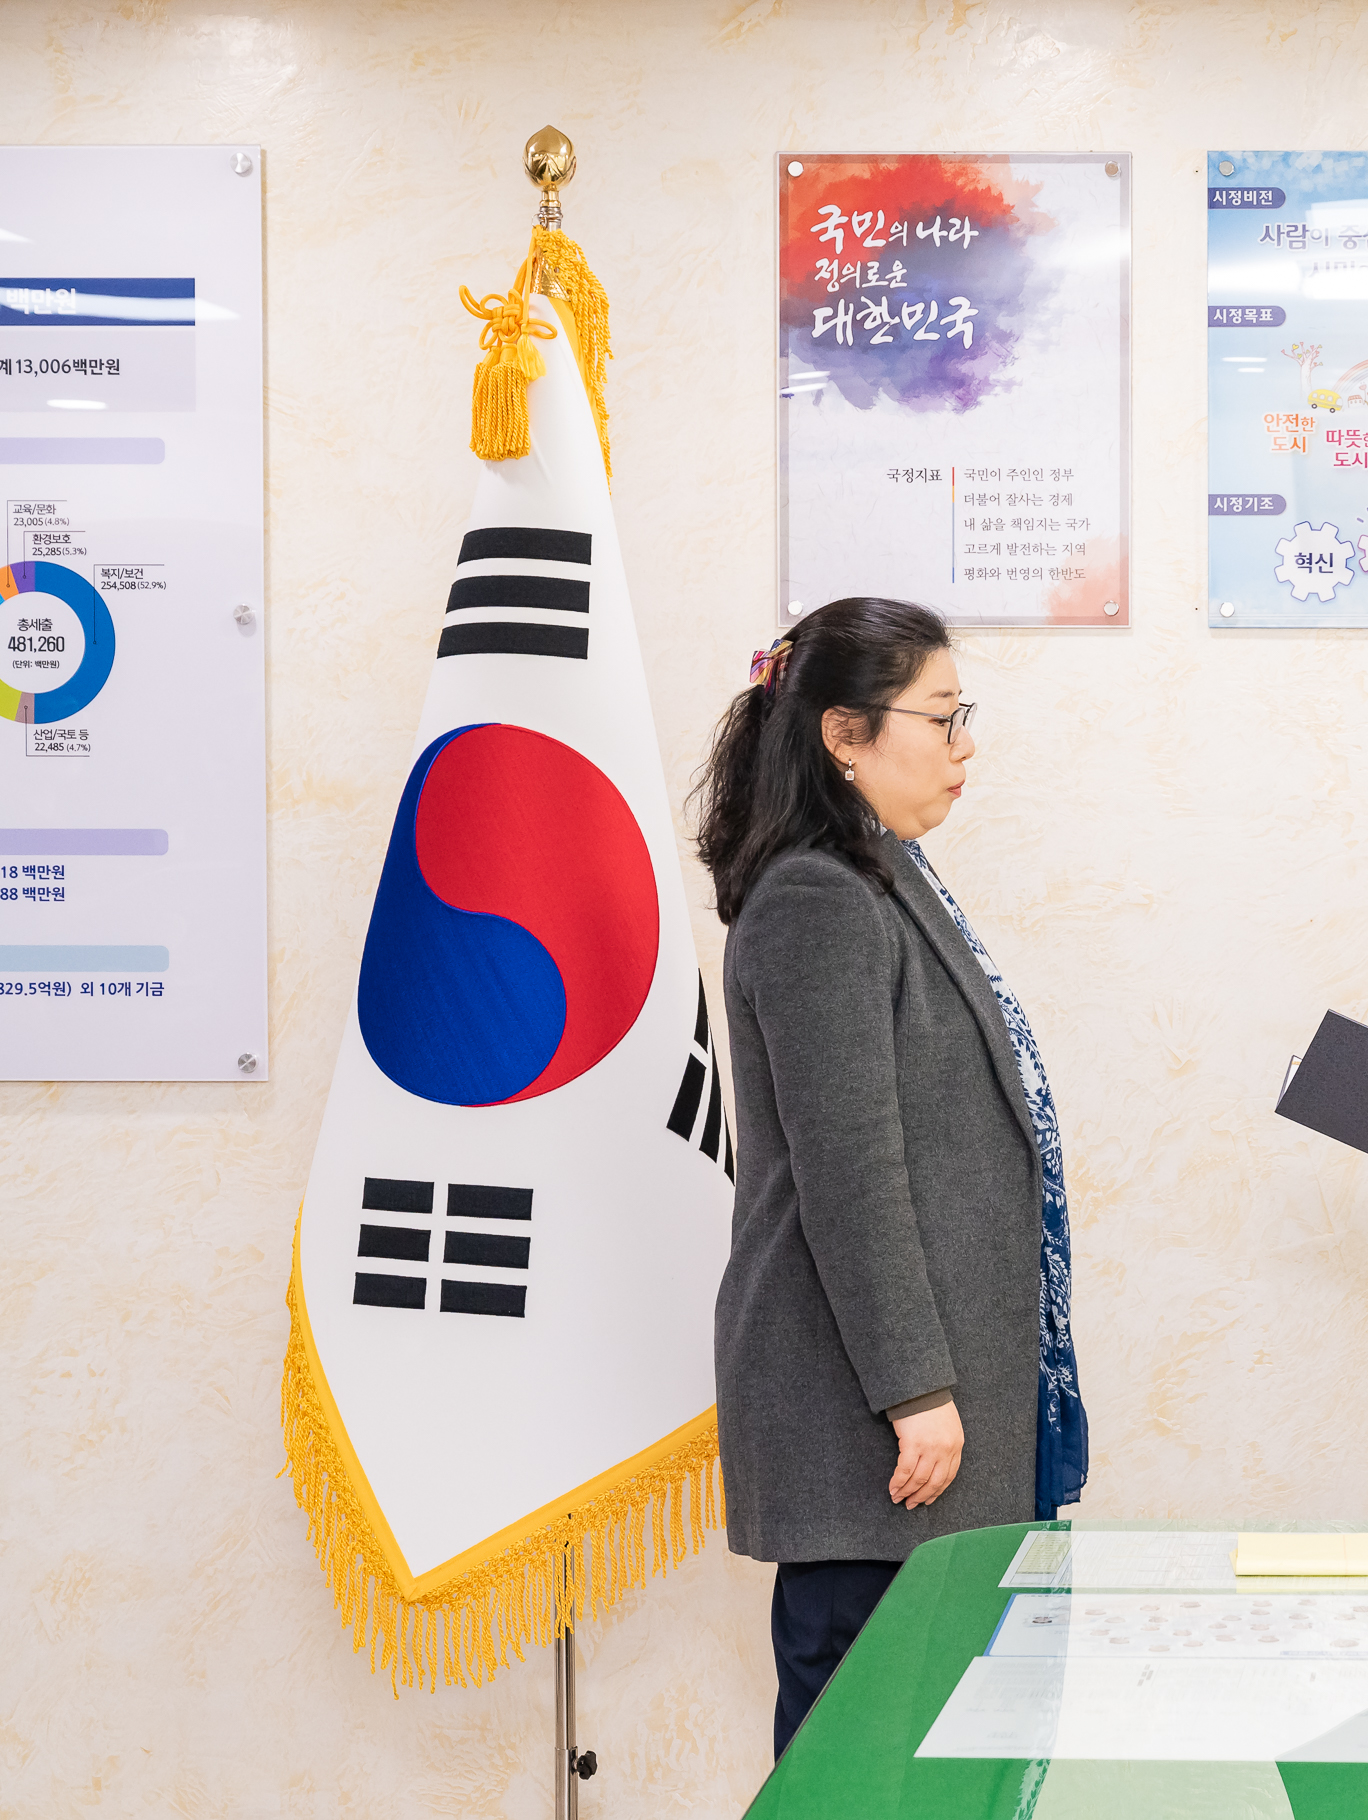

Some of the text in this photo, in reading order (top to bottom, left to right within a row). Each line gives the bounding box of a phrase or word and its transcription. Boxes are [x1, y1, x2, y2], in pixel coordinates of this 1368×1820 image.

[1213, 190, 1274, 206] 시정비전
[810, 204, 979, 254] 국민의 나라
[1259, 224, 1330, 249] 사람이
[814, 258, 908, 292] 정의로운
[6, 288, 76, 315] 백만원
[811, 295, 979, 349] 대한민국
[1213, 308, 1274, 323] 시정목표
[1263, 414, 1316, 433] 안전한
[1272, 436, 1307, 453] 도시
[1333, 452, 1368, 469] 도시
[886, 468, 943, 483] 국정지표
[963, 468, 1075, 482] 국민이 주인인 정부
[963, 493, 1073, 507] 더불어 잘사는 경제
[1214, 497, 1274, 513] 시정기조
[13, 504, 56, 515] 교육/문화
[964, 517, 1091, 531] 내 삶을 책임지는 국가
[32, 534, 71, 544] 환경보호
[963, 542, 1086, 556] 고르게 발전하는 지역
[1294, 552, 1334, 574] 혁신
[100, 568, 144, 580] 복지/보건
[963, 567, 1087, 581] 평화와 번영의 한반도
[17, 618, 53, 631] 총세출
[8, 636, 65, 653] 481,260
[34, 660, 60, 669] 백만원)
[33, 729, 89, 741] 산업/국토 등
[1, 865, 65, 880] 18 백만원
[0, 887, 65, 902] 88 백만원
[80, 981, 94, 997] 외
[100, 981, 131, 997] 10개
[136, 981, 165, 997] 기금
